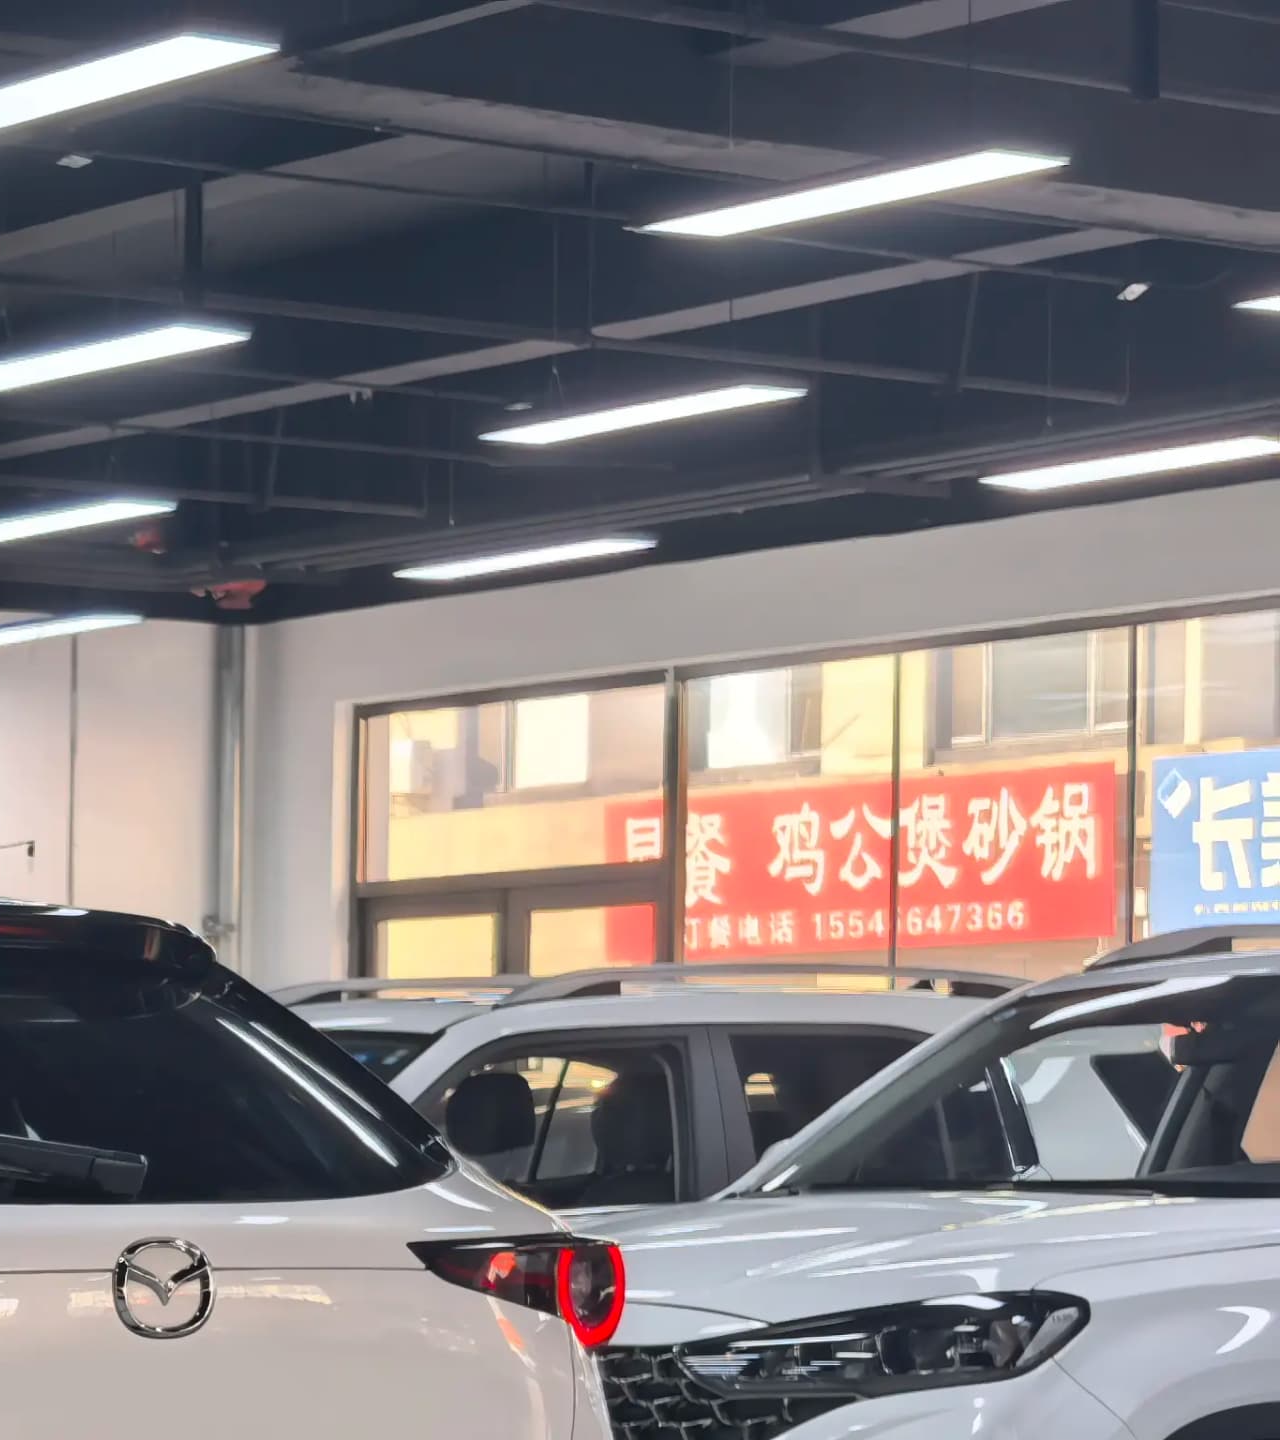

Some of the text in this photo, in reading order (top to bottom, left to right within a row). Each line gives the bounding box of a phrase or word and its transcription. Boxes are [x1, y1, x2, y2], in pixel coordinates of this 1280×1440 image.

[767, 782, 1098, 895] 鸡公煲砂锅
[814, 899, 1026, 942] 1554647366
